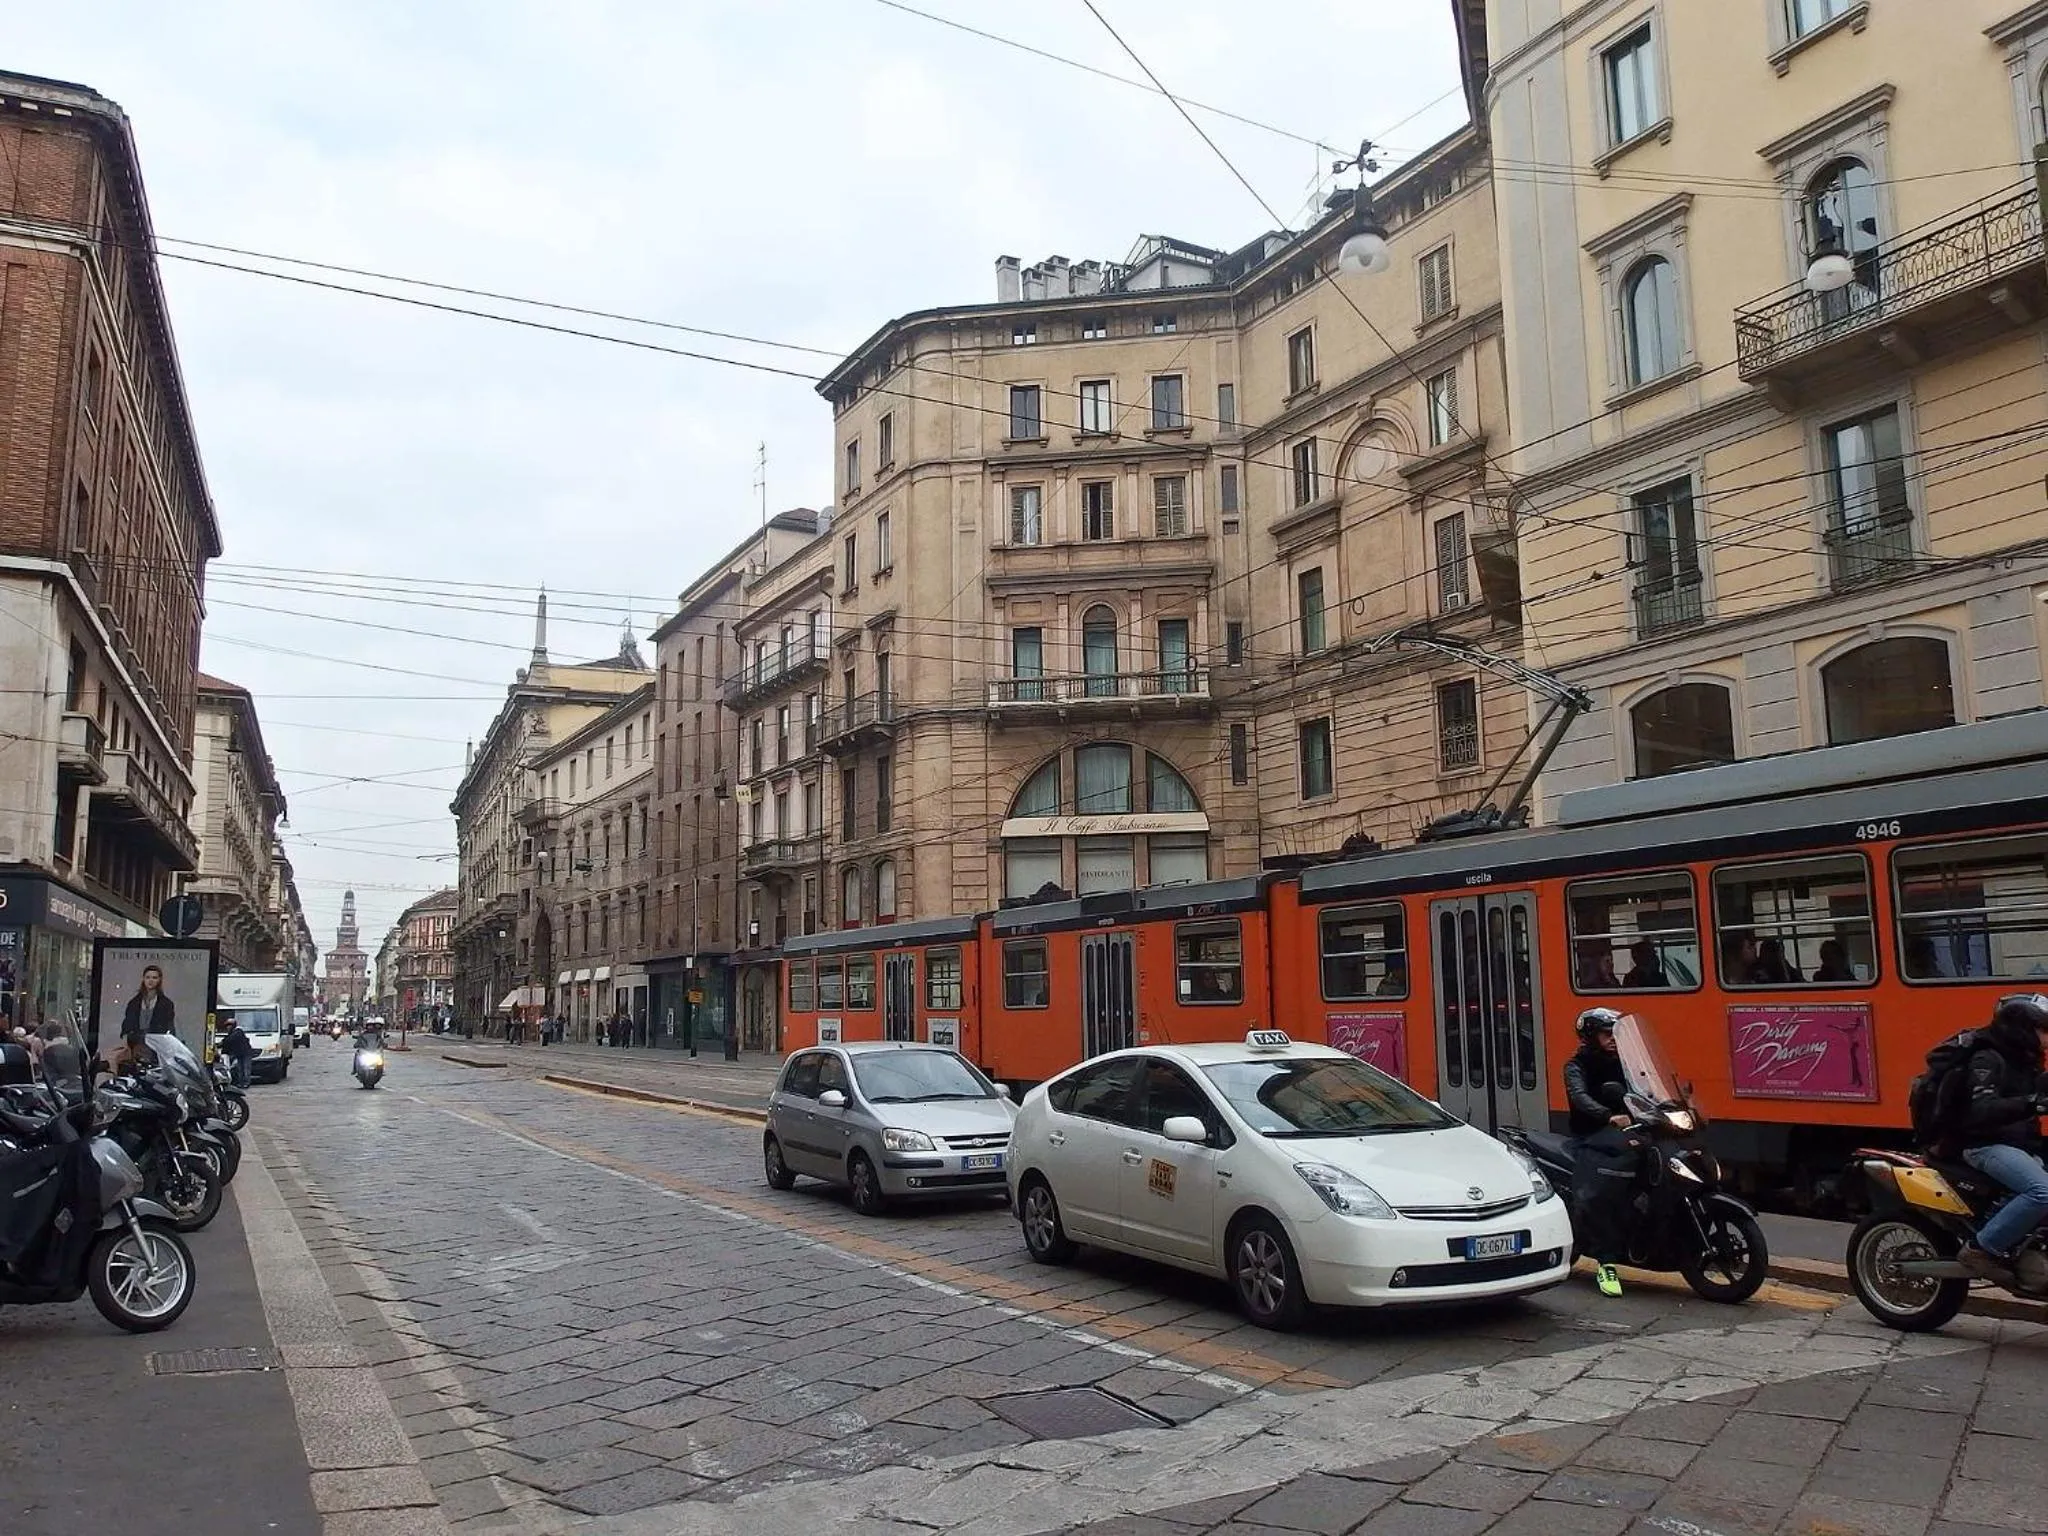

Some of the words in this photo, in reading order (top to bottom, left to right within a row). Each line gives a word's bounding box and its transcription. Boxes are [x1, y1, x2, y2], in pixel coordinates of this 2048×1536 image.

[1039, 816, 1059, 833] Il
[1855, 820, 1901, 839] 4946
[1465, 872, 1492, 885] uscita
[1254, 1032, 1288, 1045] TAXI
[1735, 1013, 1815, 1053] Dirty
[1749, 1035, 1828, 1081] Dancing
